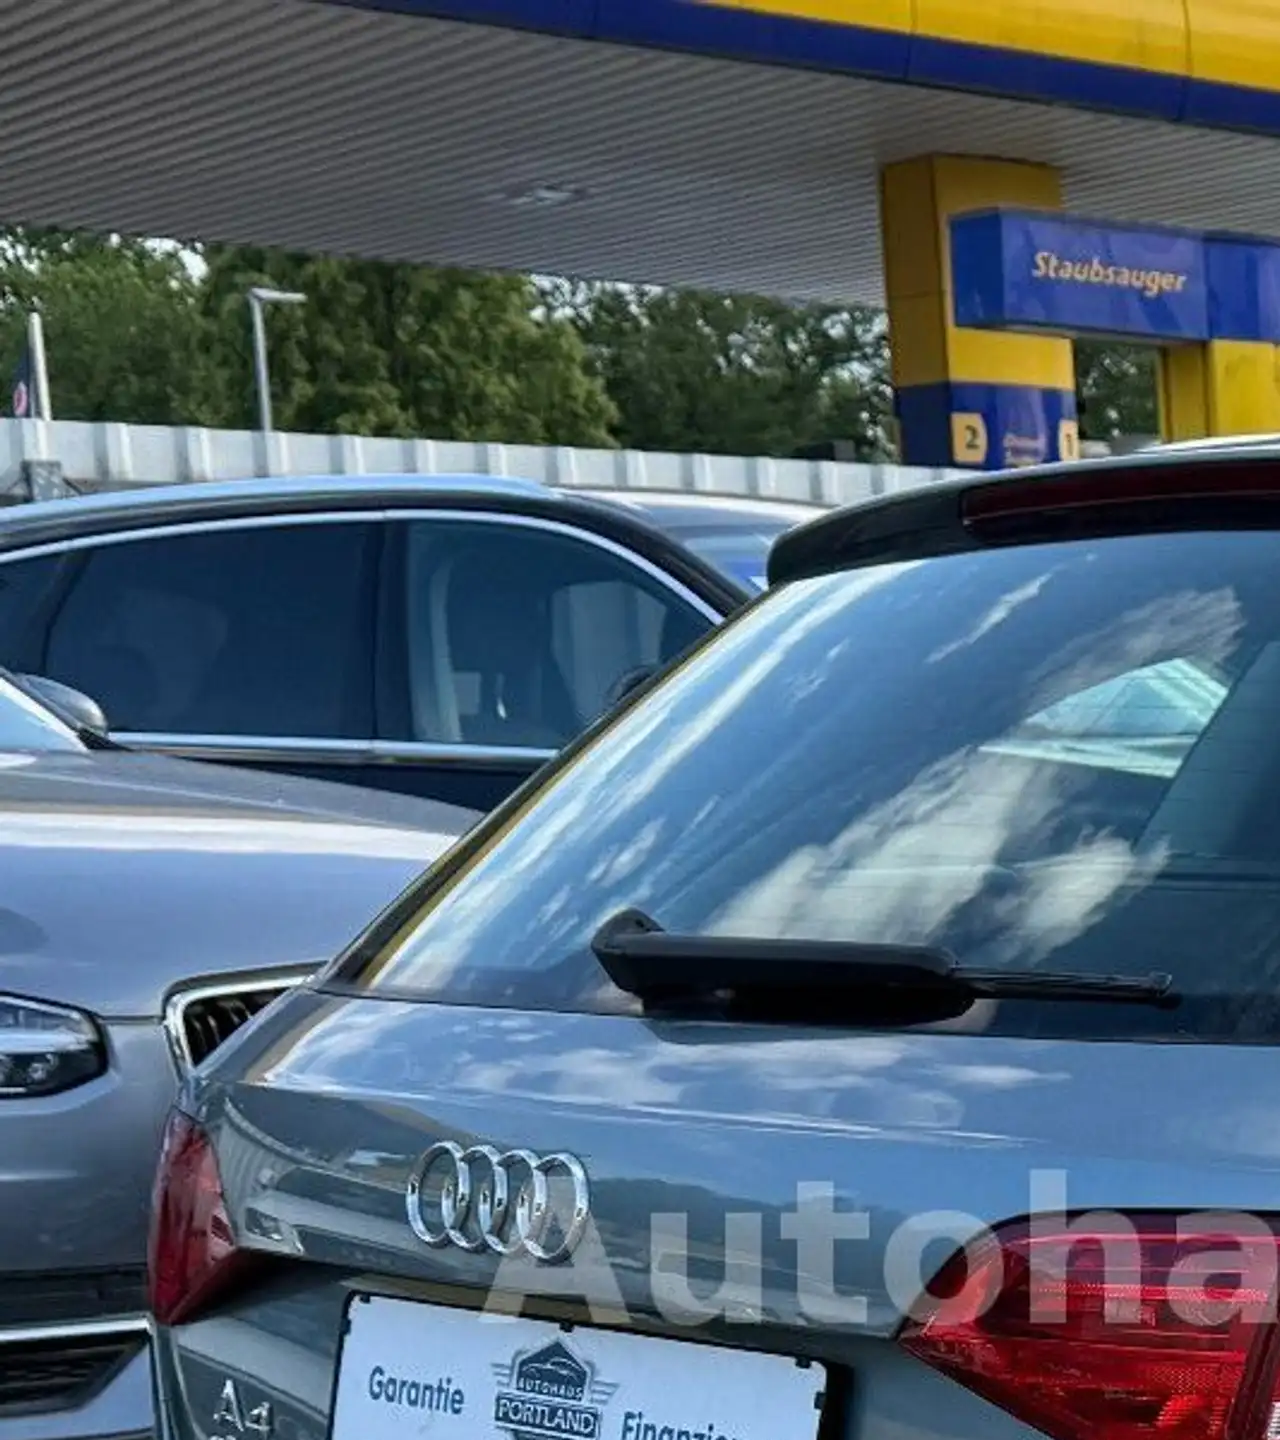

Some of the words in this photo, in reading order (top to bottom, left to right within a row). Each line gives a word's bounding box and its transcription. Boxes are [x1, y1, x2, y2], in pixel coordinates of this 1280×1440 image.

[1032, 250, 1188, 299] Staubsauger
[964, 423, 981, 451] 2
[1064, 432, 1075, 458] 1
[368, 1364, 465, 1416] Garantie
[517, 1377, 584, 1399] AUTOHAUS
[212, 1379, 271, 1440] A4
[497, 1398, 596, 1435] PORTLAND
